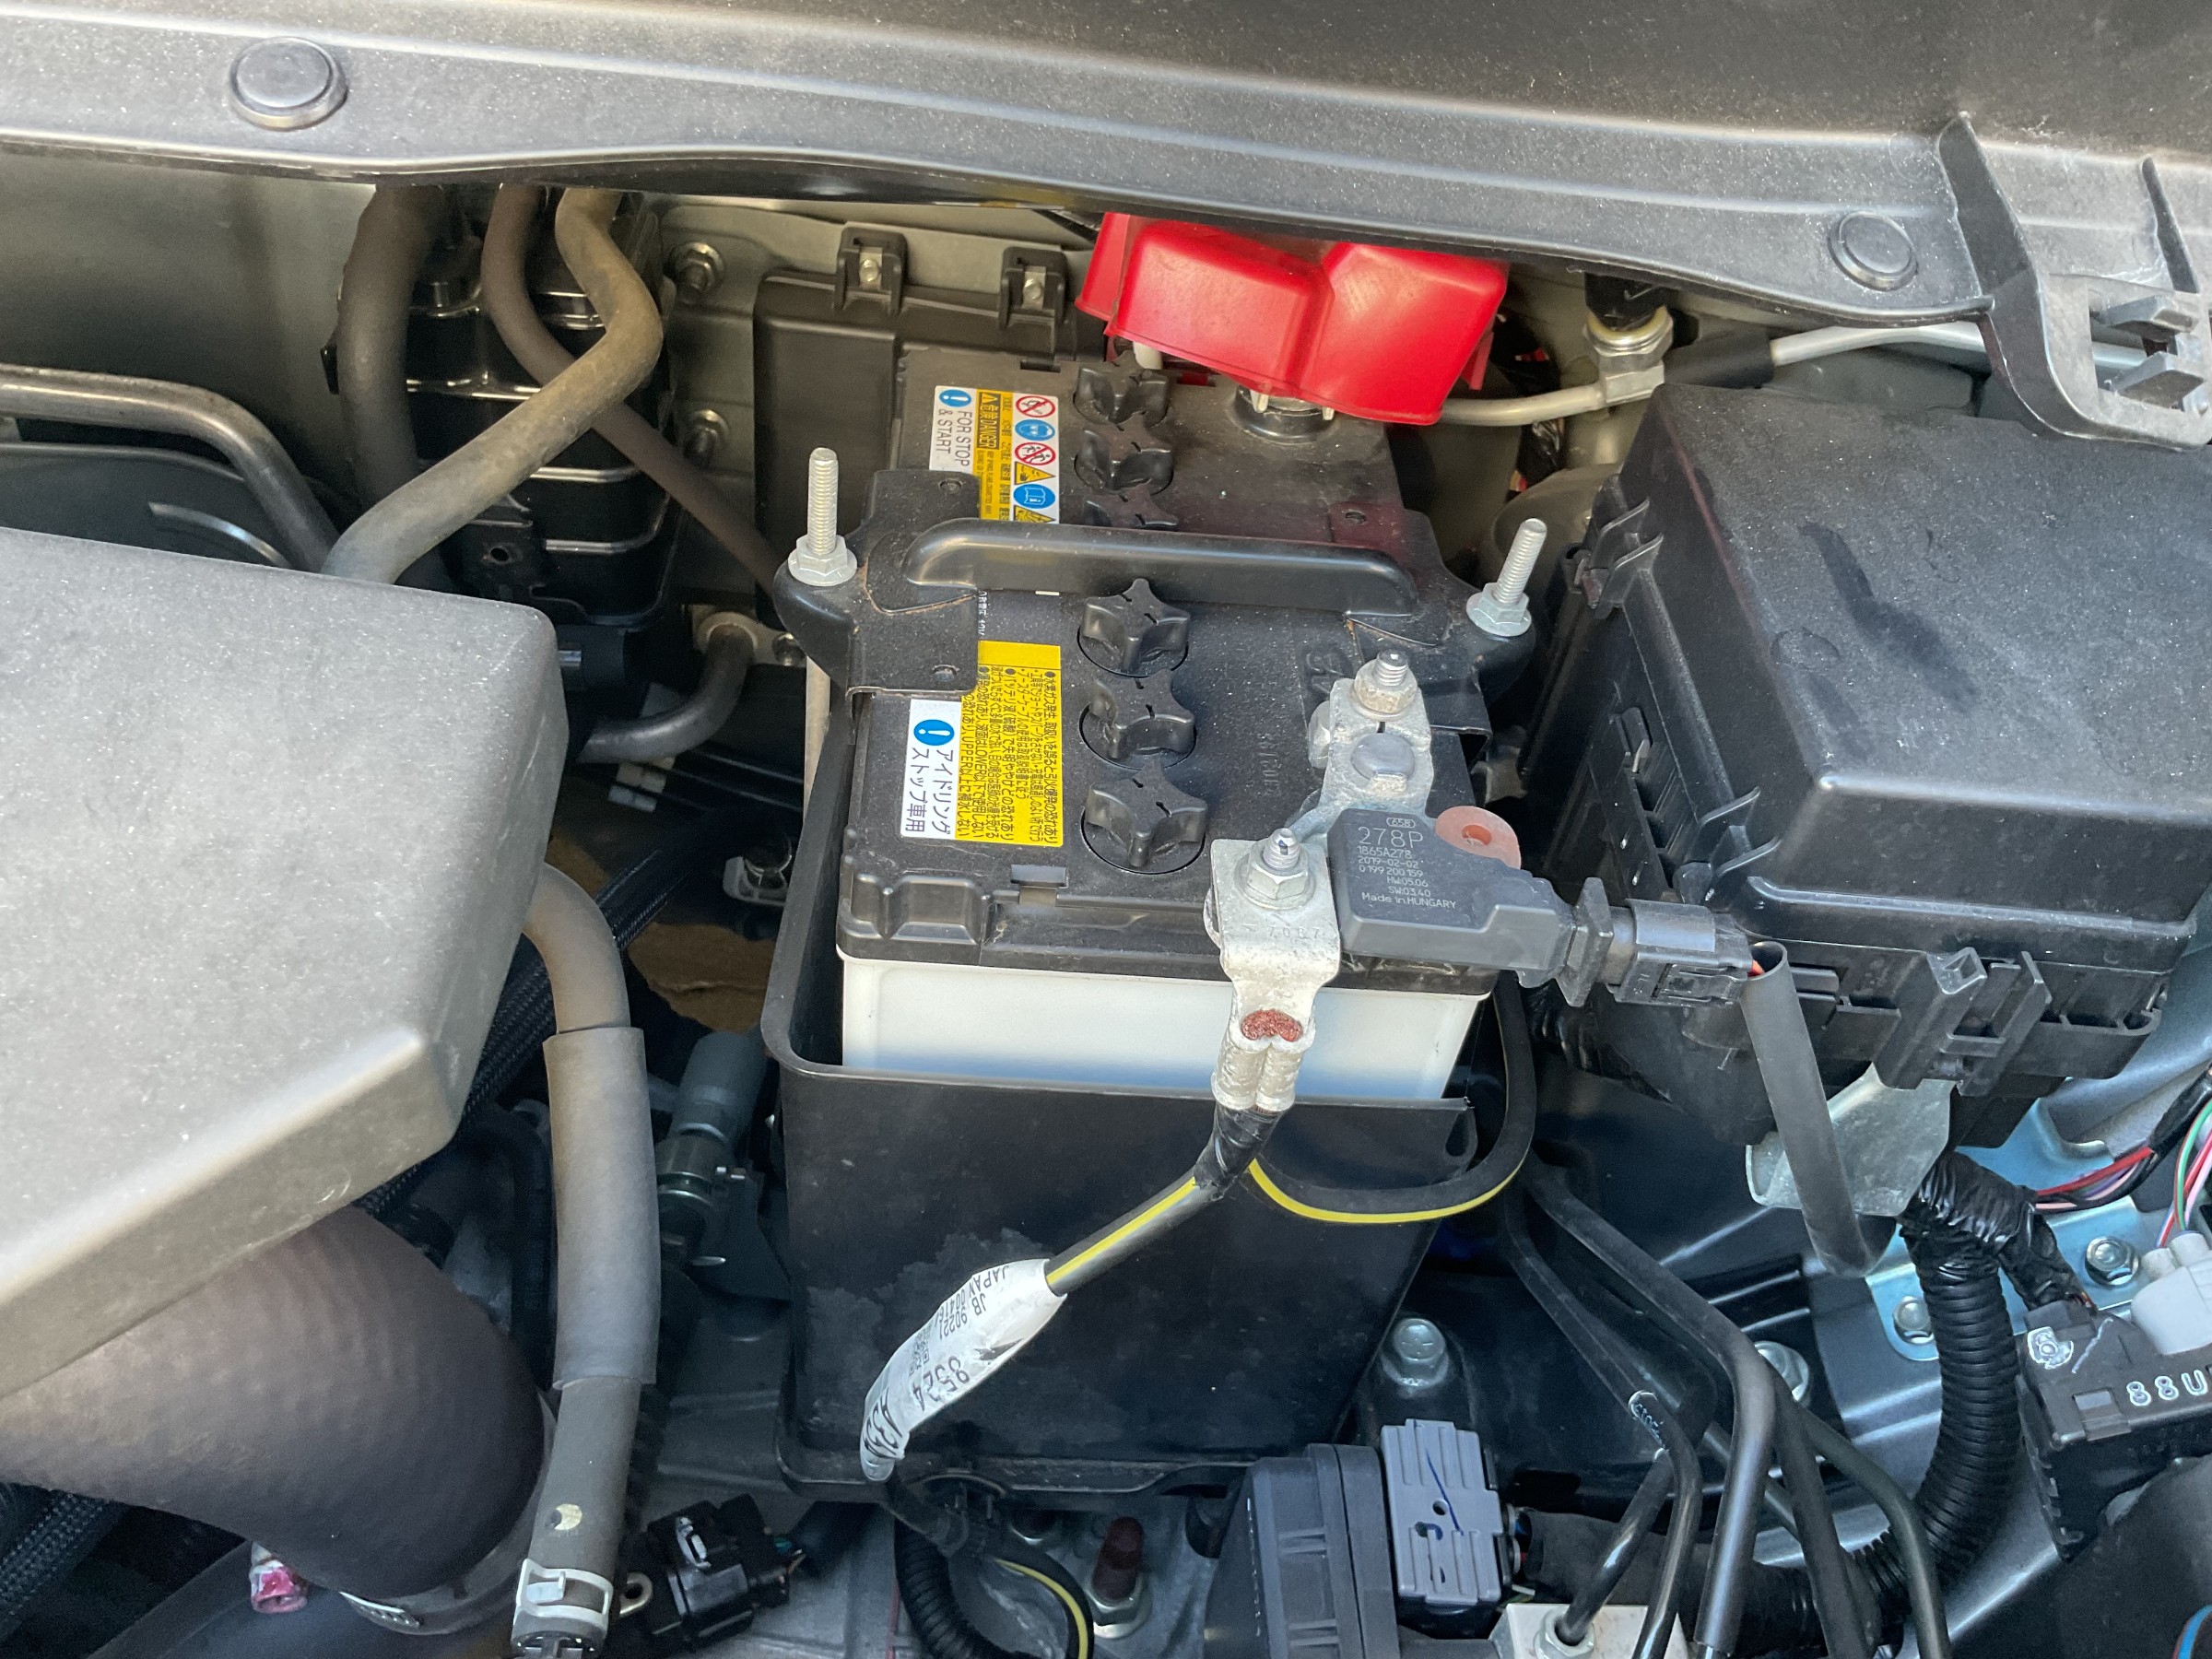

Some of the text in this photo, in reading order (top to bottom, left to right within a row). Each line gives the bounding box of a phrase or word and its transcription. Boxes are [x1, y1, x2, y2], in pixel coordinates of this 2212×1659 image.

[936, 418, 953, 454] START
[955, 411, 972, 467] FOR STOP
[905, 747, 930, 832] ストップ車用
[932, 748, 954, 835] アイドリング
[1357, 846, 1413, 859] 1865A278
[1358, 826, 1424, 848] 278P
[1358, 856, 1419, 868] 2019-02-02
[1361, 891, 1456, 909] Made in HUNGARY
[969, 1265, 1010, 1300] JAPAN
[971, 1292, 987, 1316] JB
[912, 1355, 971, 1412] 8524
[2125, 1369, 2209, 1407] 88U
